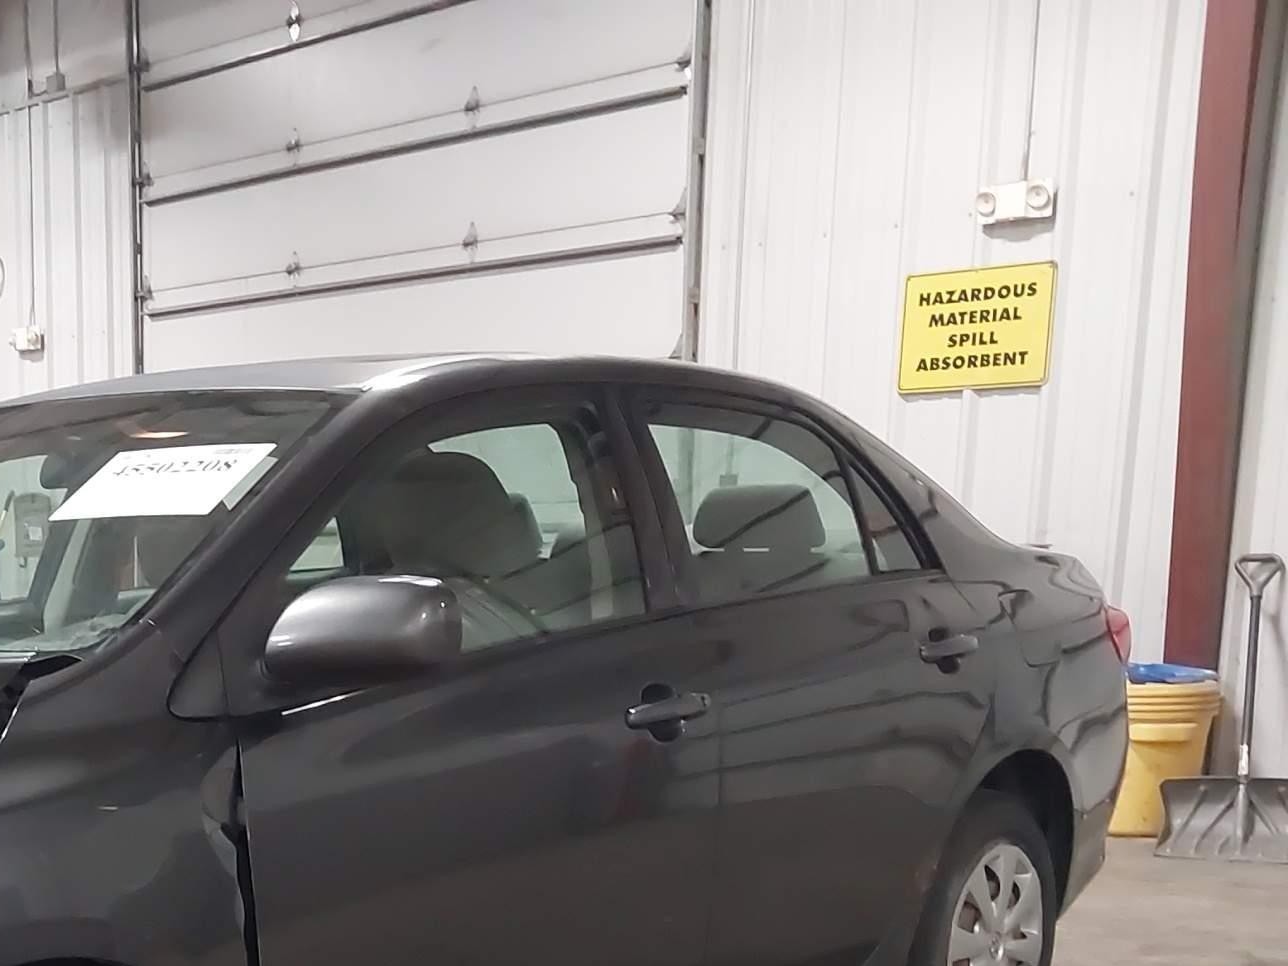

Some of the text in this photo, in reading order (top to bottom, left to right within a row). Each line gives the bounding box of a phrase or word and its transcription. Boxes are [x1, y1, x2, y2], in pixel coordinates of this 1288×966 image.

[919, 282, 1038, 307] HAZARDOUS
[928, 306, 1023, 328] MATERIAL
[947, 331, 999, 348] SPILL
[915, 351, 1029, 372] ABSORBENT
